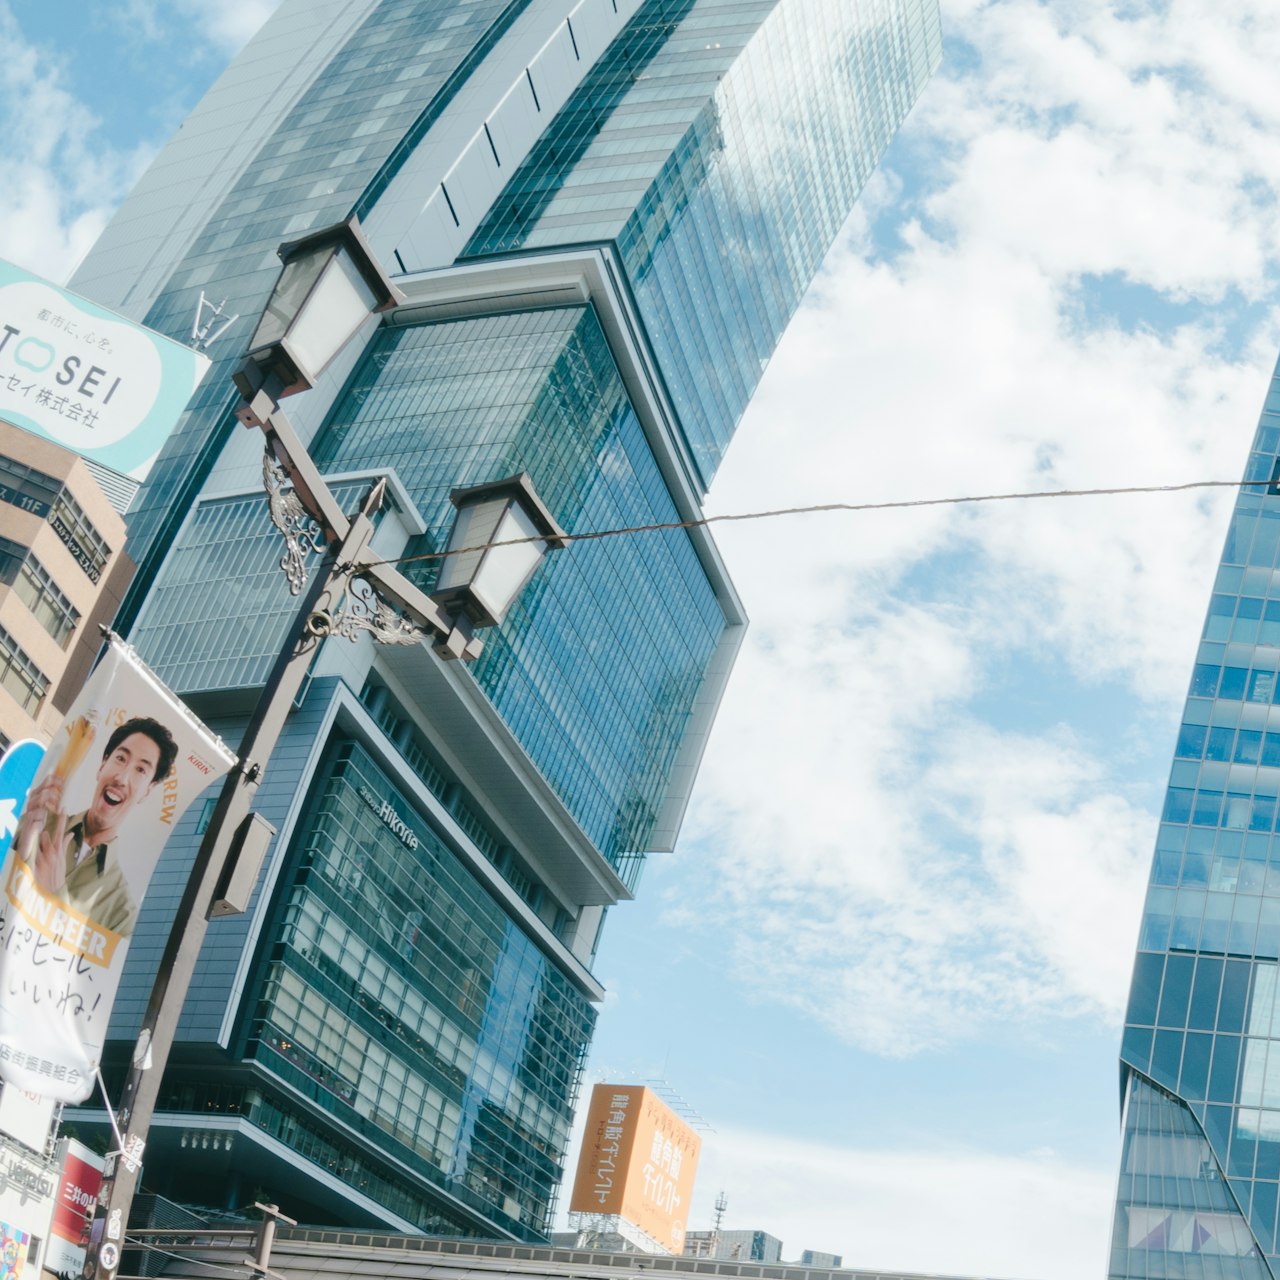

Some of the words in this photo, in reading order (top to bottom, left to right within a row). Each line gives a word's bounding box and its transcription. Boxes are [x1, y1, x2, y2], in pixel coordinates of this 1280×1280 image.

[20, 496, 42, 513] 11F
[187, 754, 210, 776] KIRIN
[379, 799, 419, 851] Hikarie
[49, 904, 109, 960] BEER
